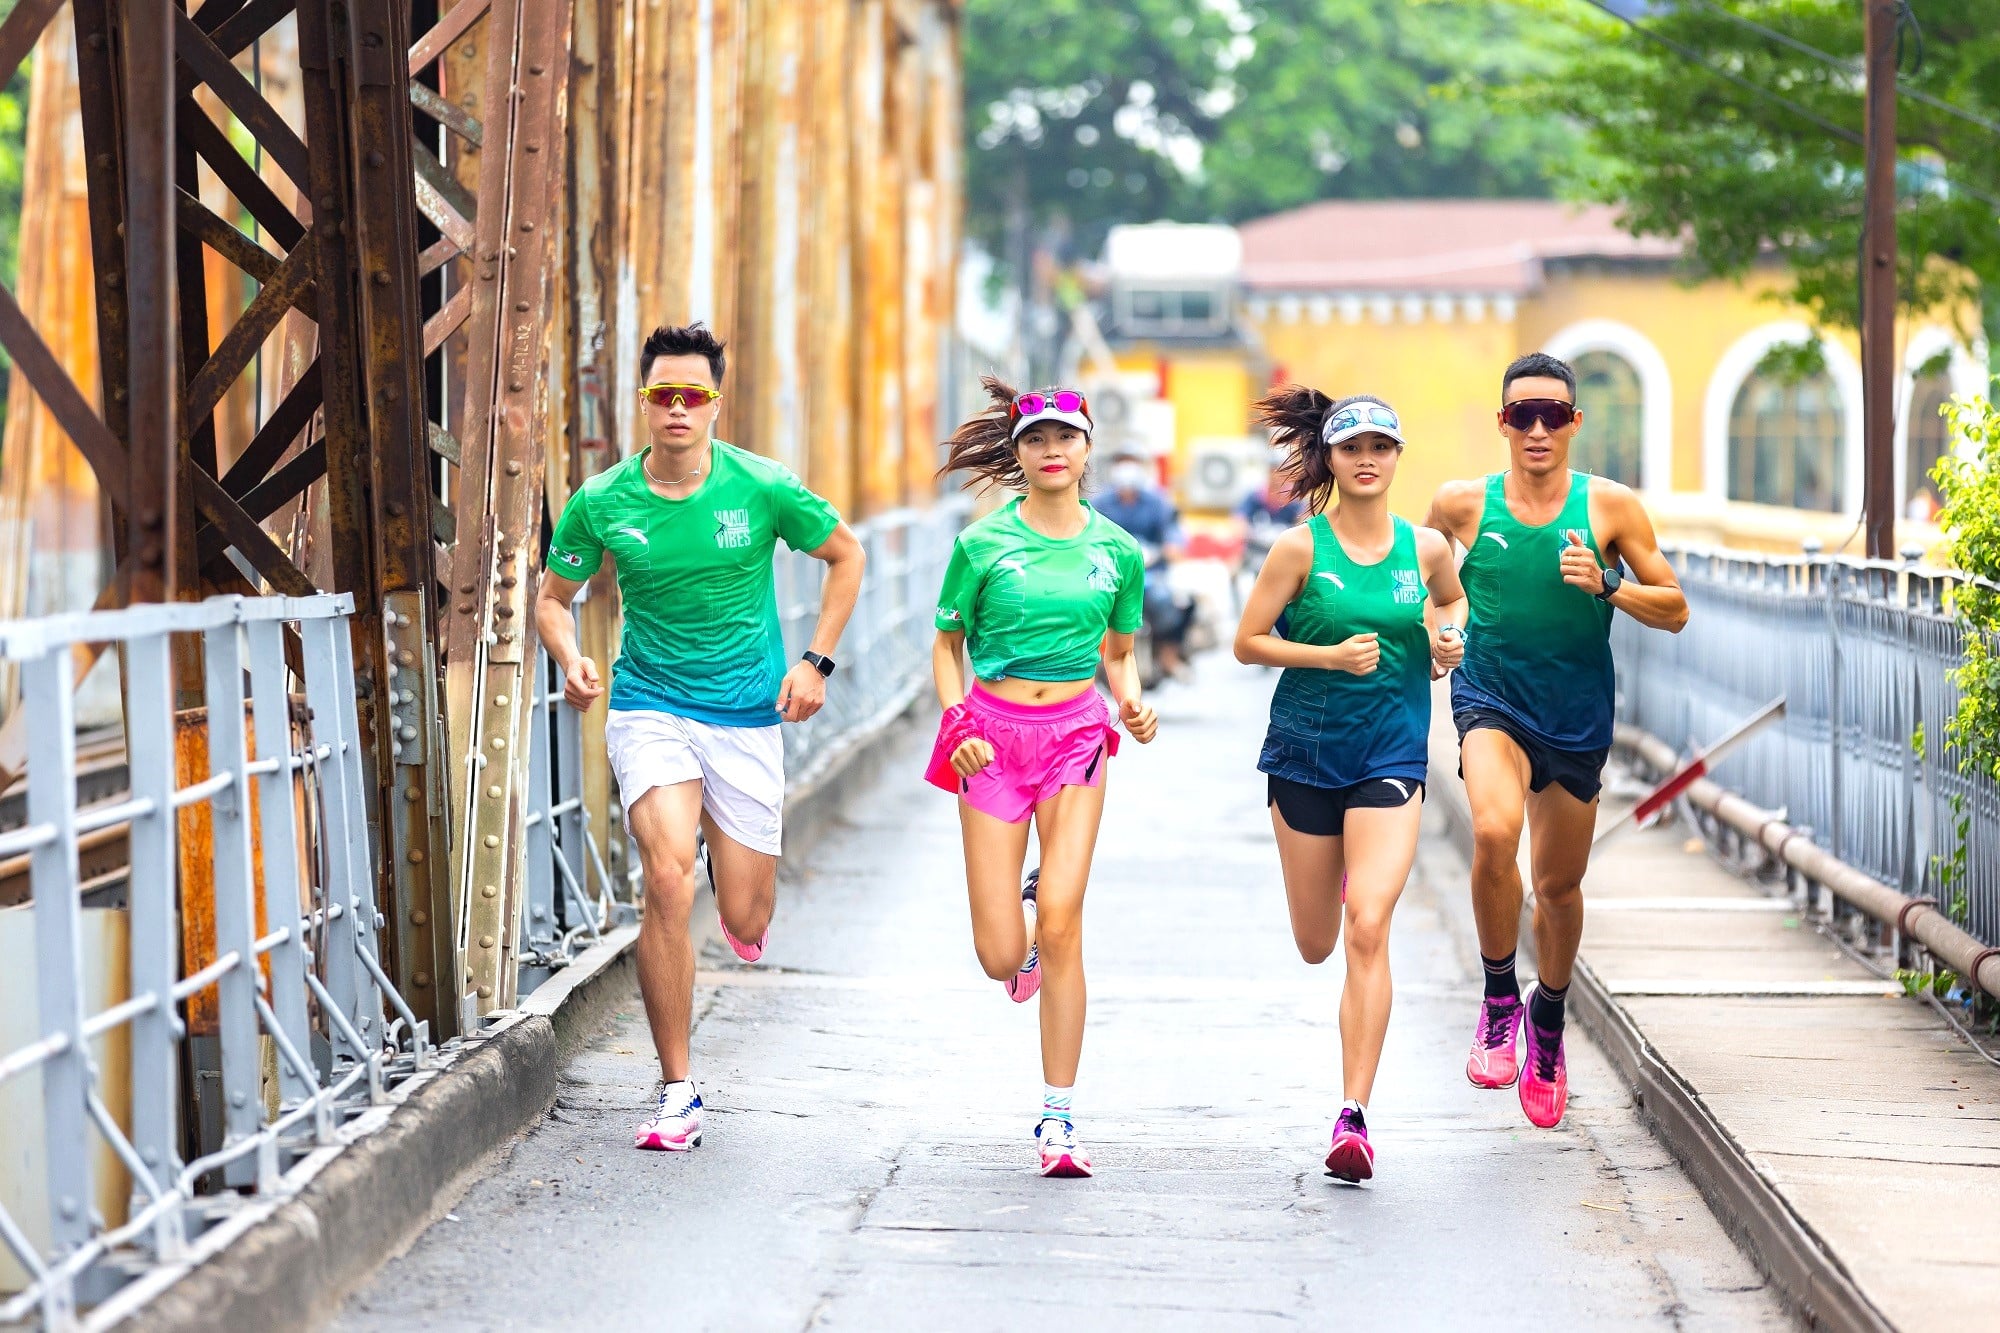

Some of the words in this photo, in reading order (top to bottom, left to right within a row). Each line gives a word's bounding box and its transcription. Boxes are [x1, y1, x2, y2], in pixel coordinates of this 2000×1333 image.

[716, 532, 752, 549] VIBES
[1559, 528, 1589, 545] HOI
[1393, 590, 1421, 604] VIBES
